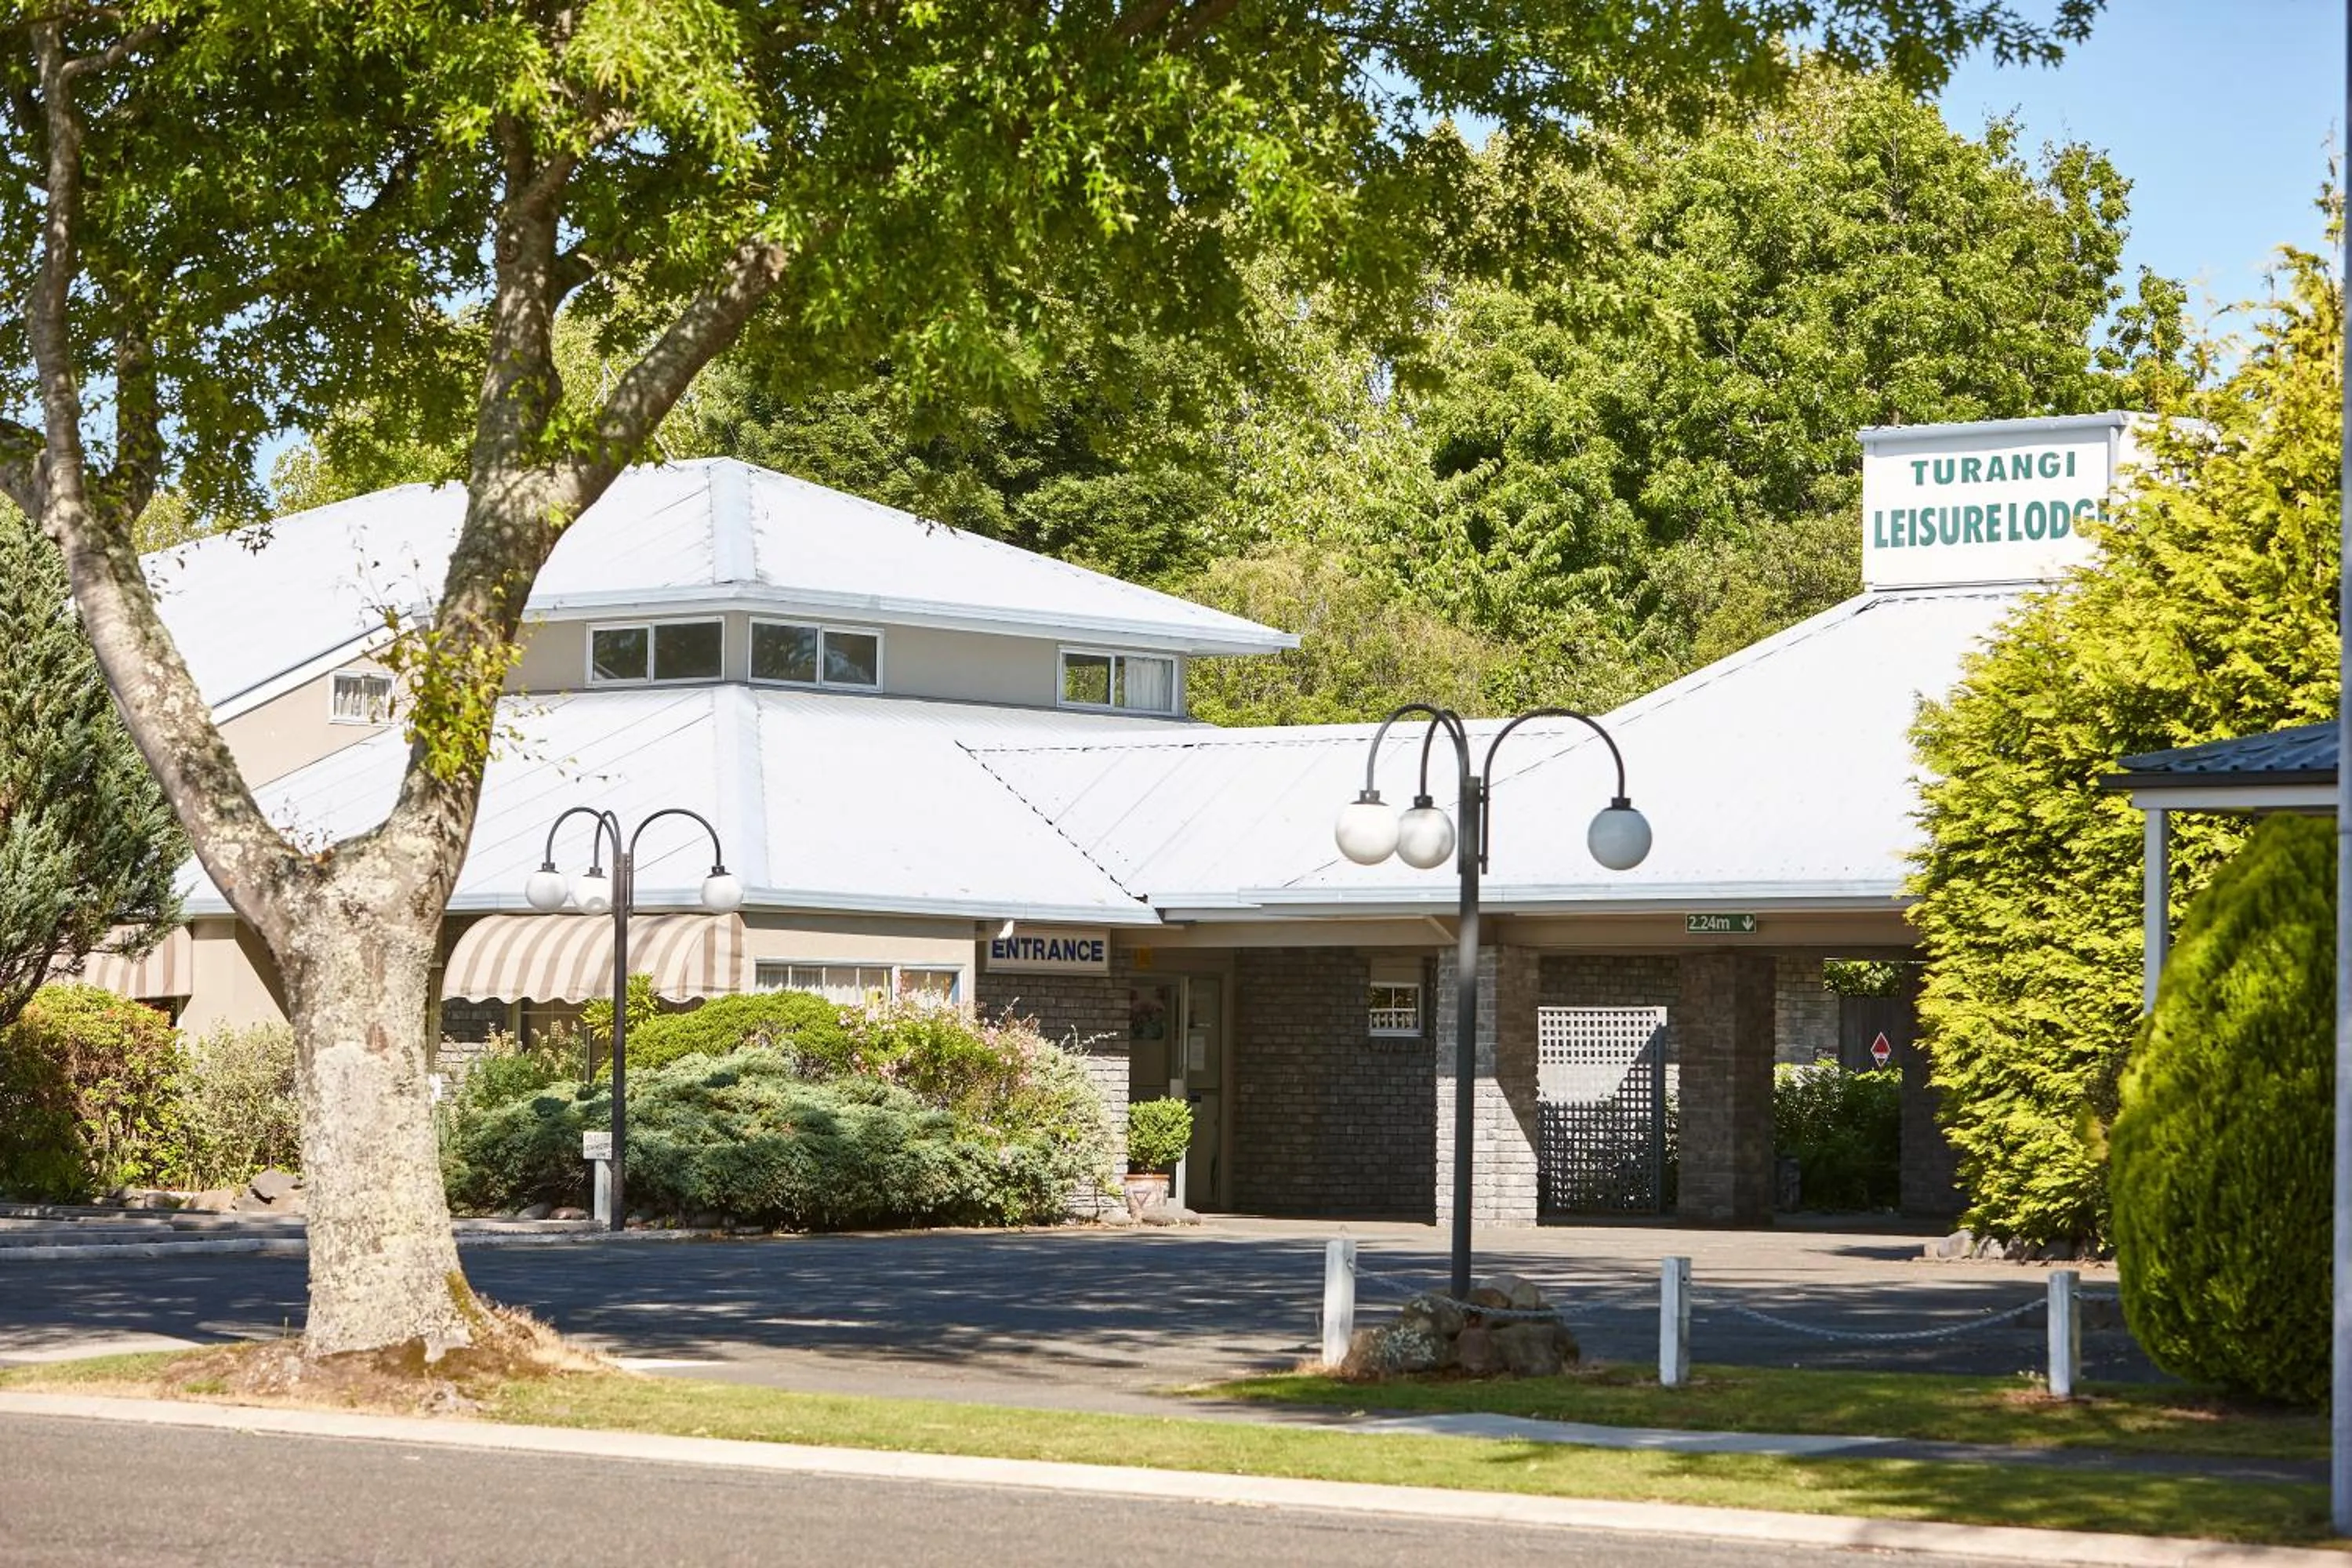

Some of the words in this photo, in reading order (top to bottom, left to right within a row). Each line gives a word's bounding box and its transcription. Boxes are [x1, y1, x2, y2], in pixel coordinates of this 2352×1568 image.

[1911, 452, 2076, 485] TURANGI
[1689, 915, 1730, 931] 2.24m
[992, 938, 1104, 961] ENTRANCE
